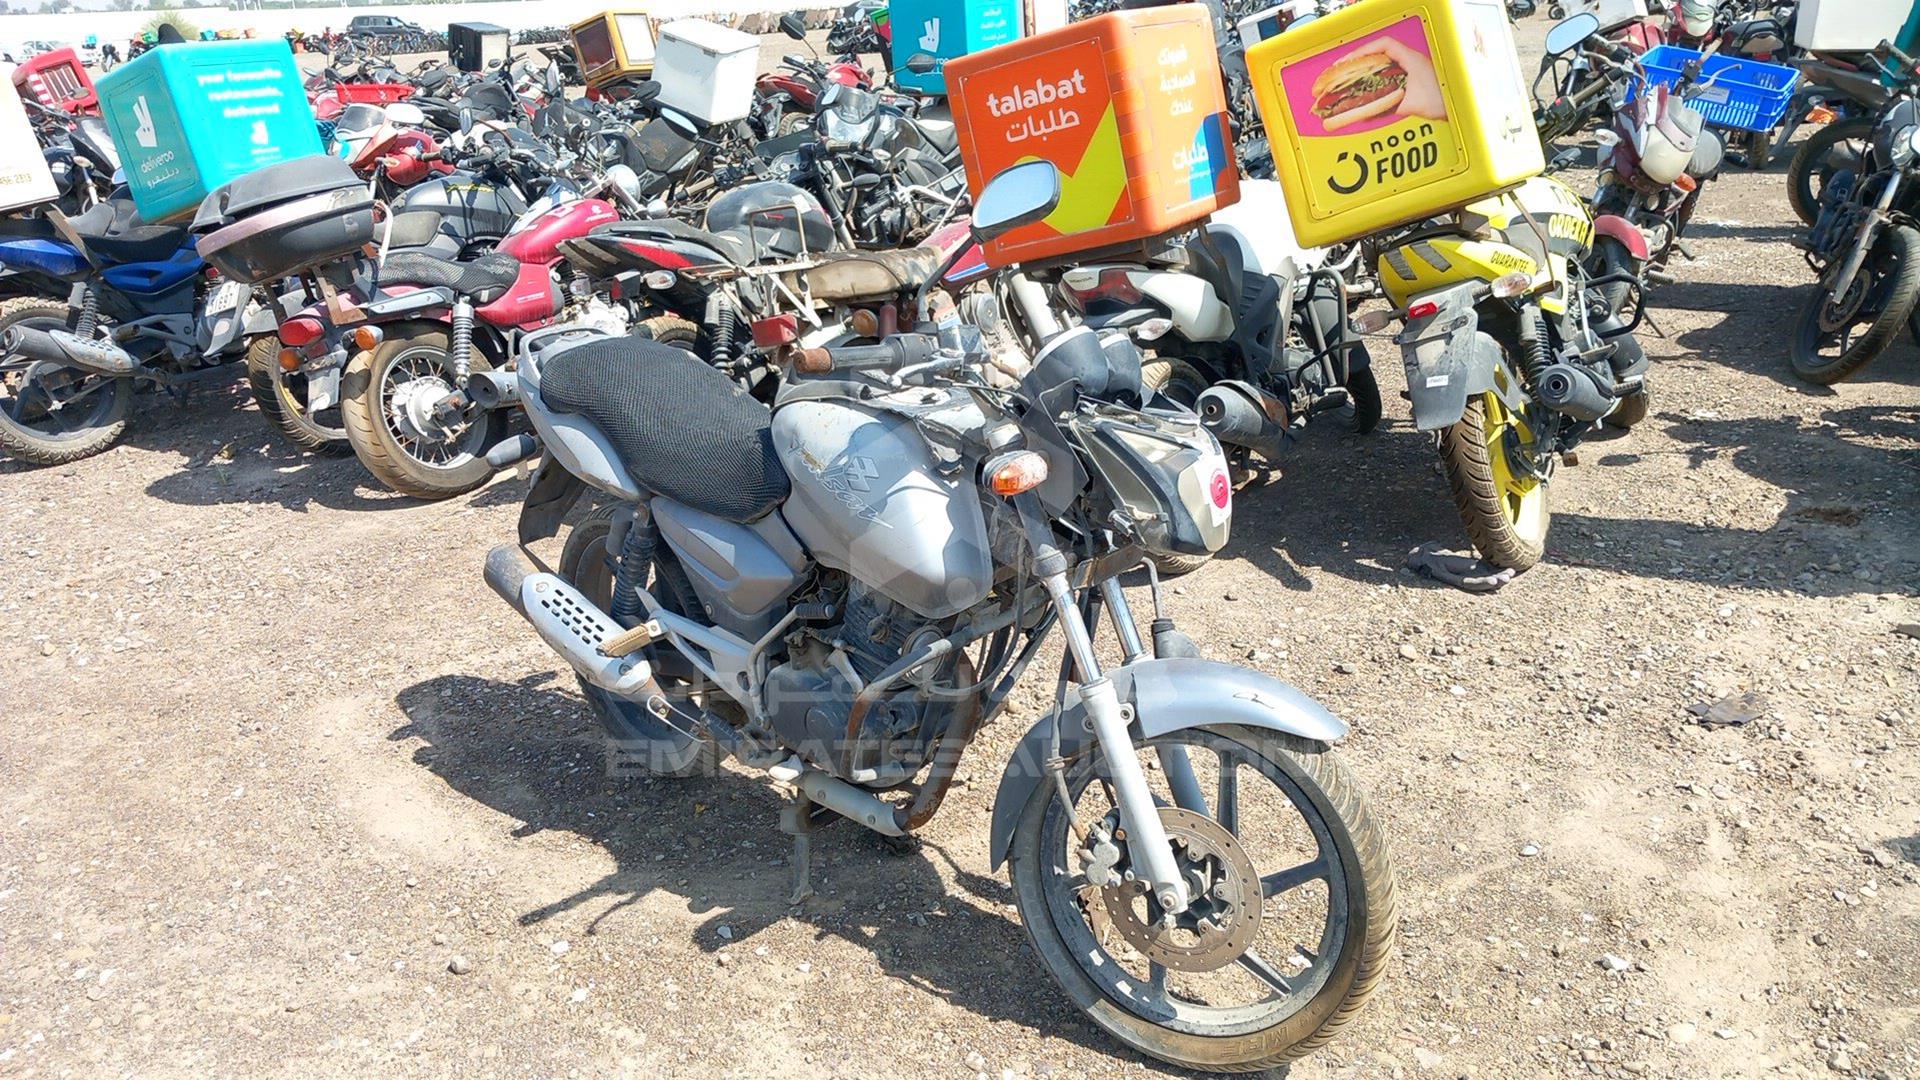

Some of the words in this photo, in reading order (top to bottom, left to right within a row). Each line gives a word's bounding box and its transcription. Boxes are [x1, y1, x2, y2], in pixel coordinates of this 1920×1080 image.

[986, 68, 1087, 118] talabat
[1005, 108, 1080, 143] طلبات
[1370, 123, 1433, 154] noon
[141, 150, 175, 174] deliveroo
[1376, 141, 1438, 184] FOOD
[1490, 250, 1530, 274] GUARANTEE
